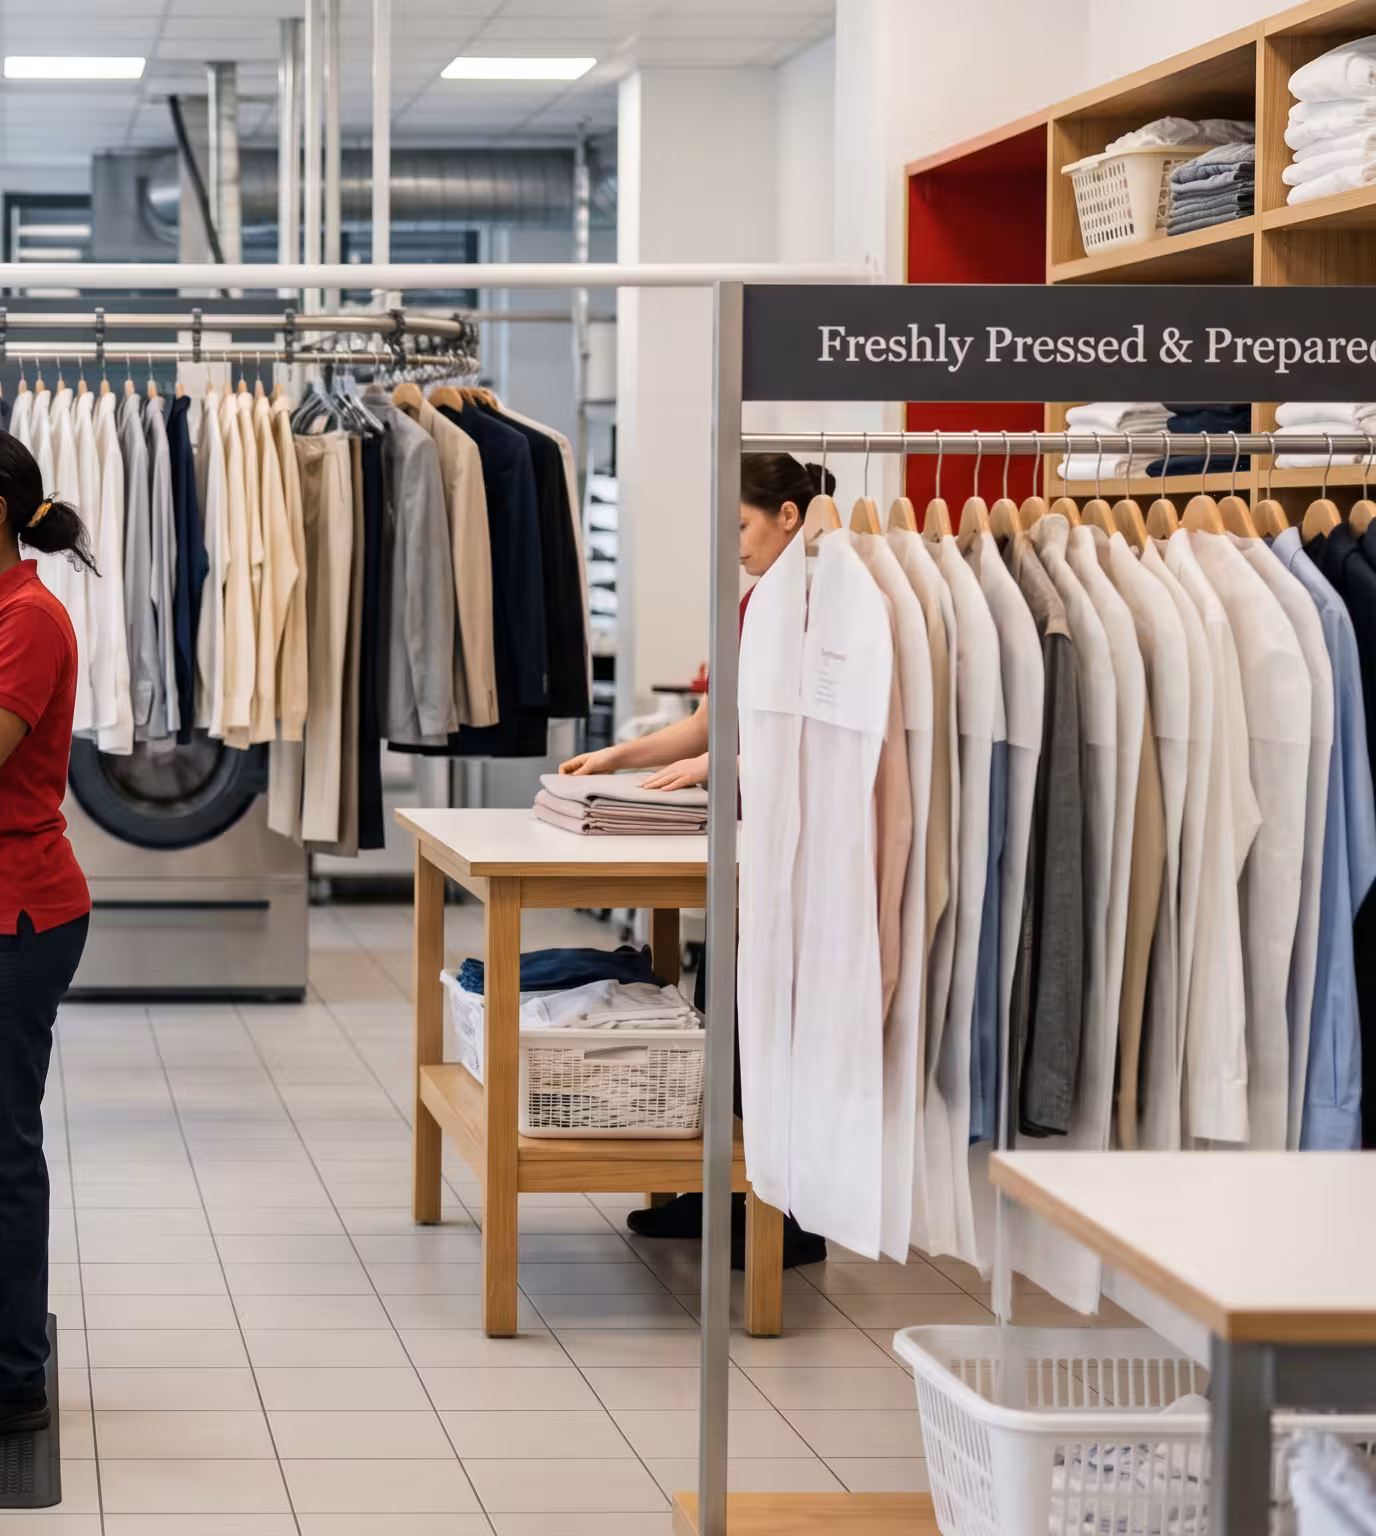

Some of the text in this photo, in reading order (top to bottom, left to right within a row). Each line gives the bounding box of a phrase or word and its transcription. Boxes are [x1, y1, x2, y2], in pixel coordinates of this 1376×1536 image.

[817, 323, 1376, 375] Freshly Pressed & Prepare
